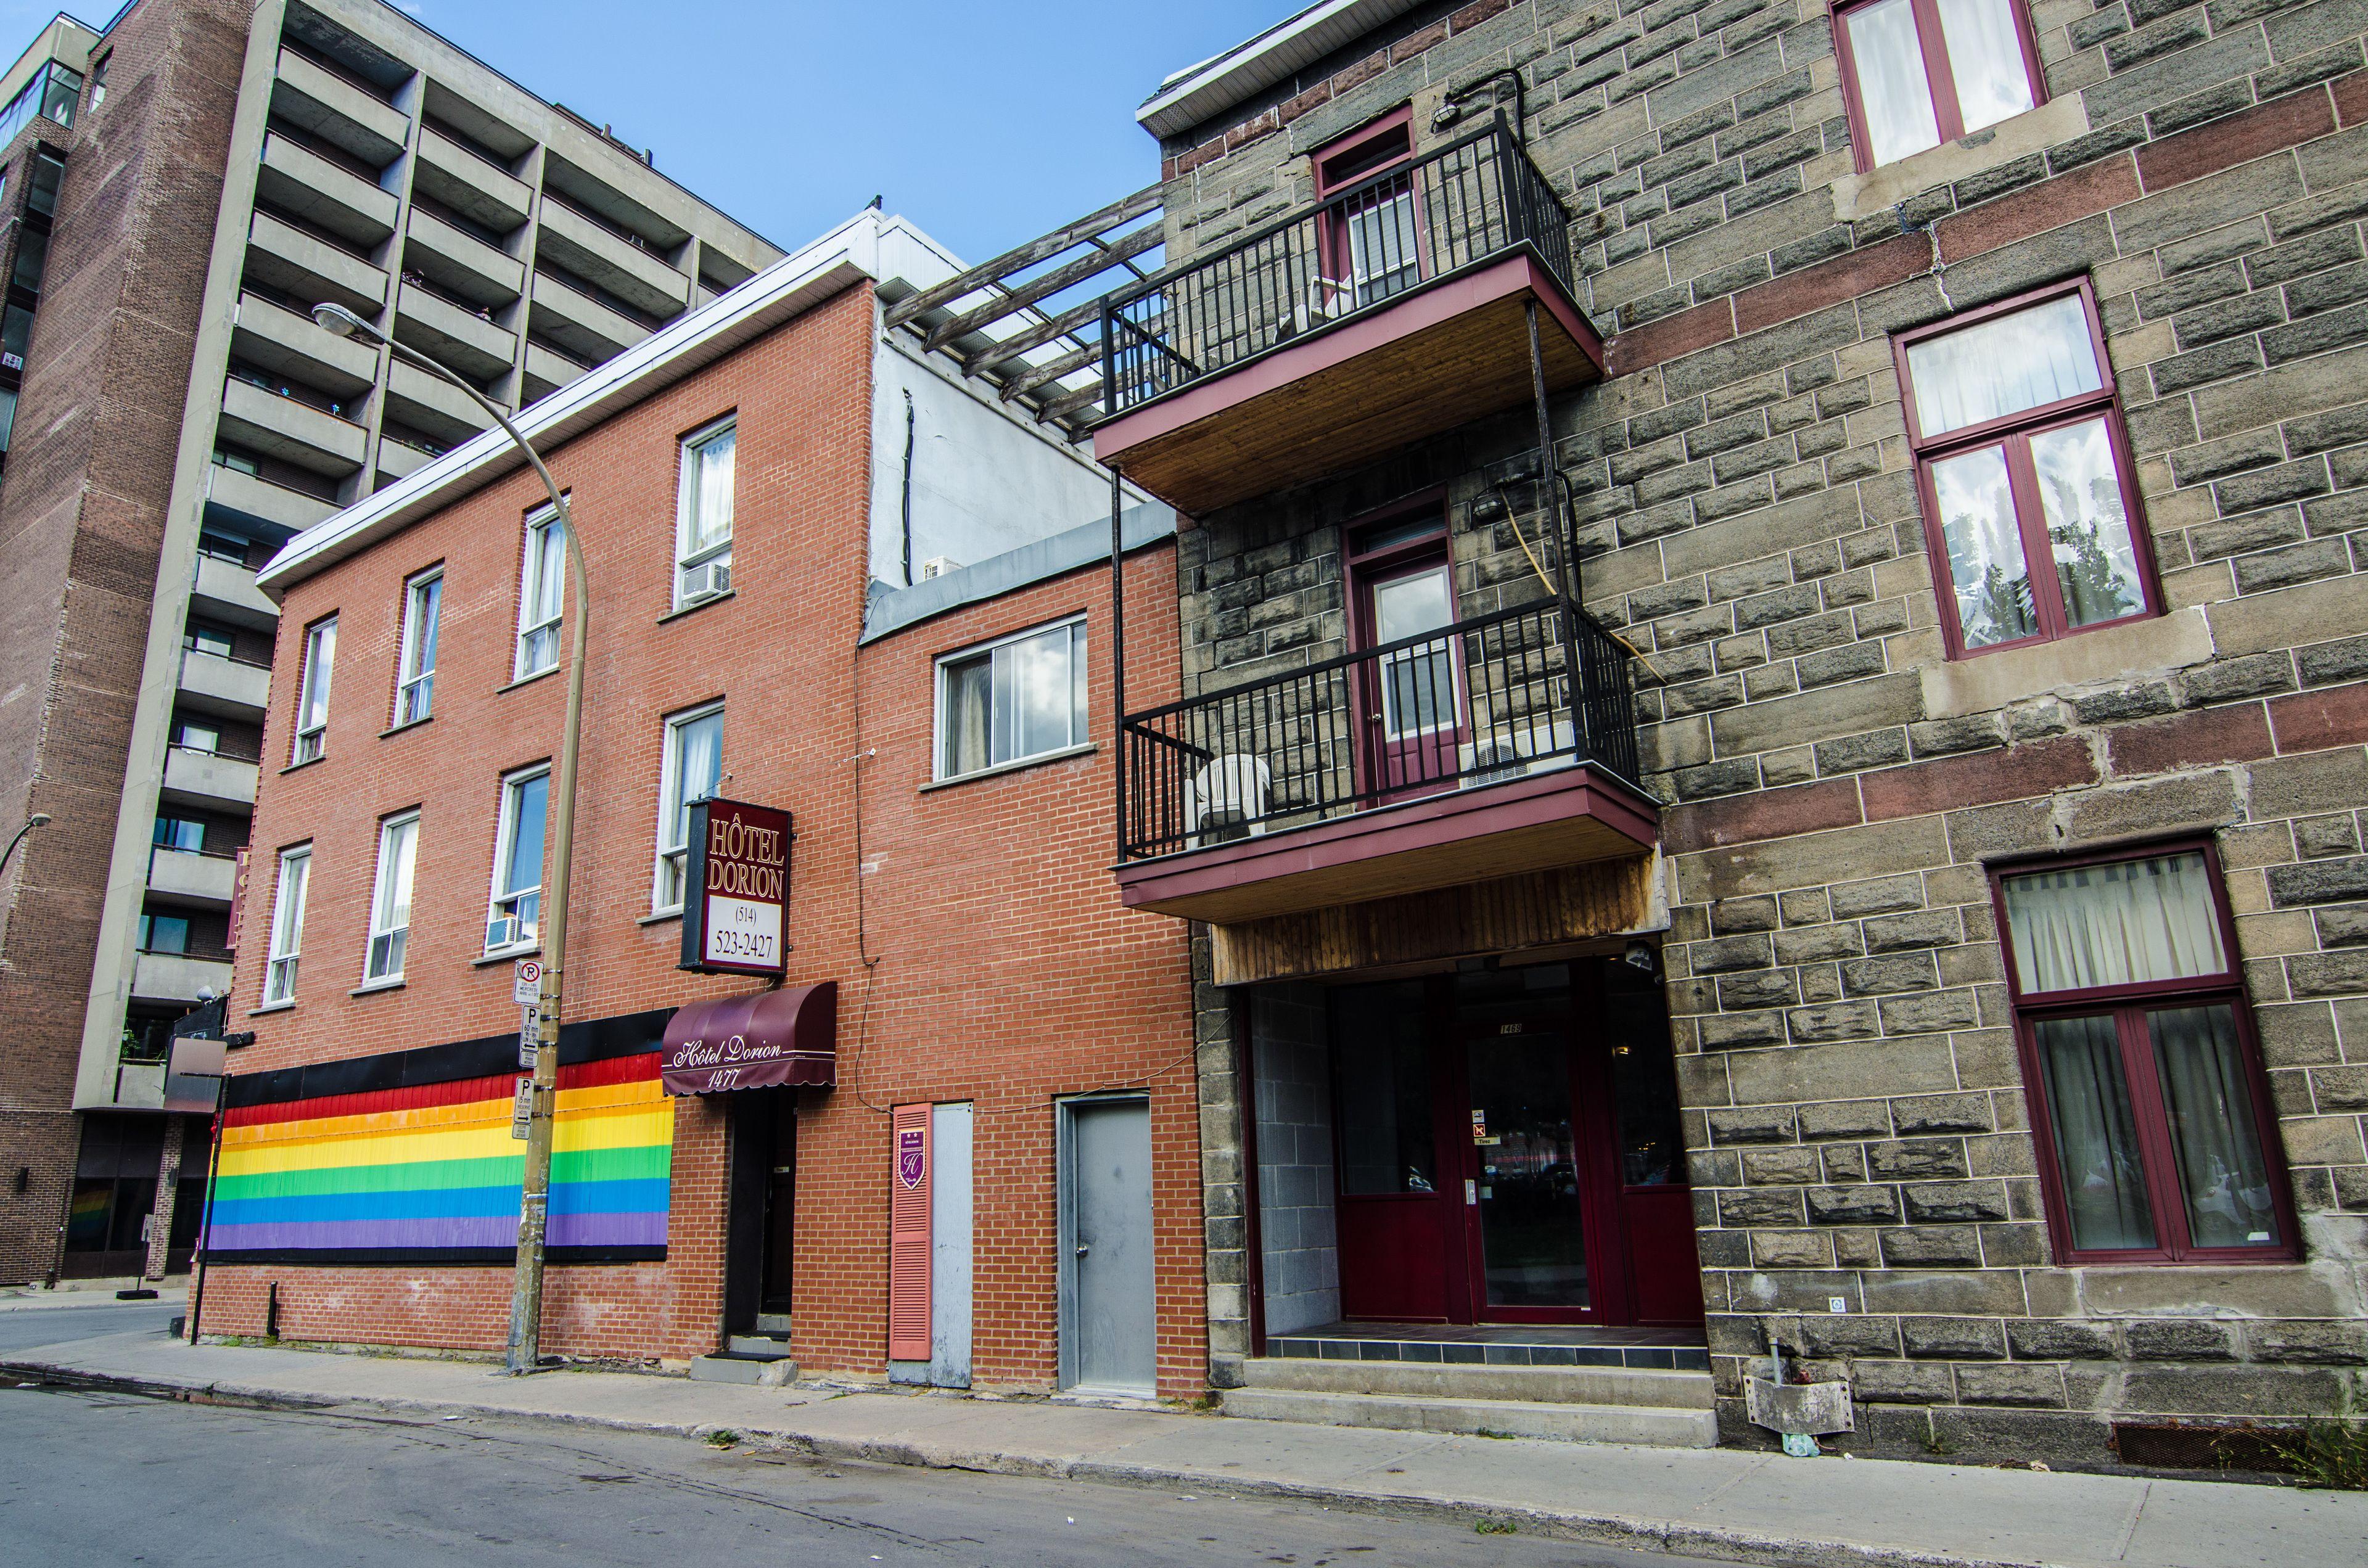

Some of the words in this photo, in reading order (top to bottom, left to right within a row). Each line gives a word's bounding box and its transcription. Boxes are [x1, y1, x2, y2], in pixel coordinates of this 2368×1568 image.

[710, 813, 784, 866] HÔTEL
[708, 859, 783, 900] DORION
[735, 906, 757, 927] (514)
[715, 930, 773, 958] 523-2427
[528, 1008, 536, 1024] P
[1502, 1024, 1521, 1034] 1469
[673, 1040, 726, 1069] Hôtel
[723, 1035, 782, 1062] Dorion
[522, 1080, 530, 1096] P
[708, 1069, 742, 1088] 1477
[902, 1152, 923, 1175] H
